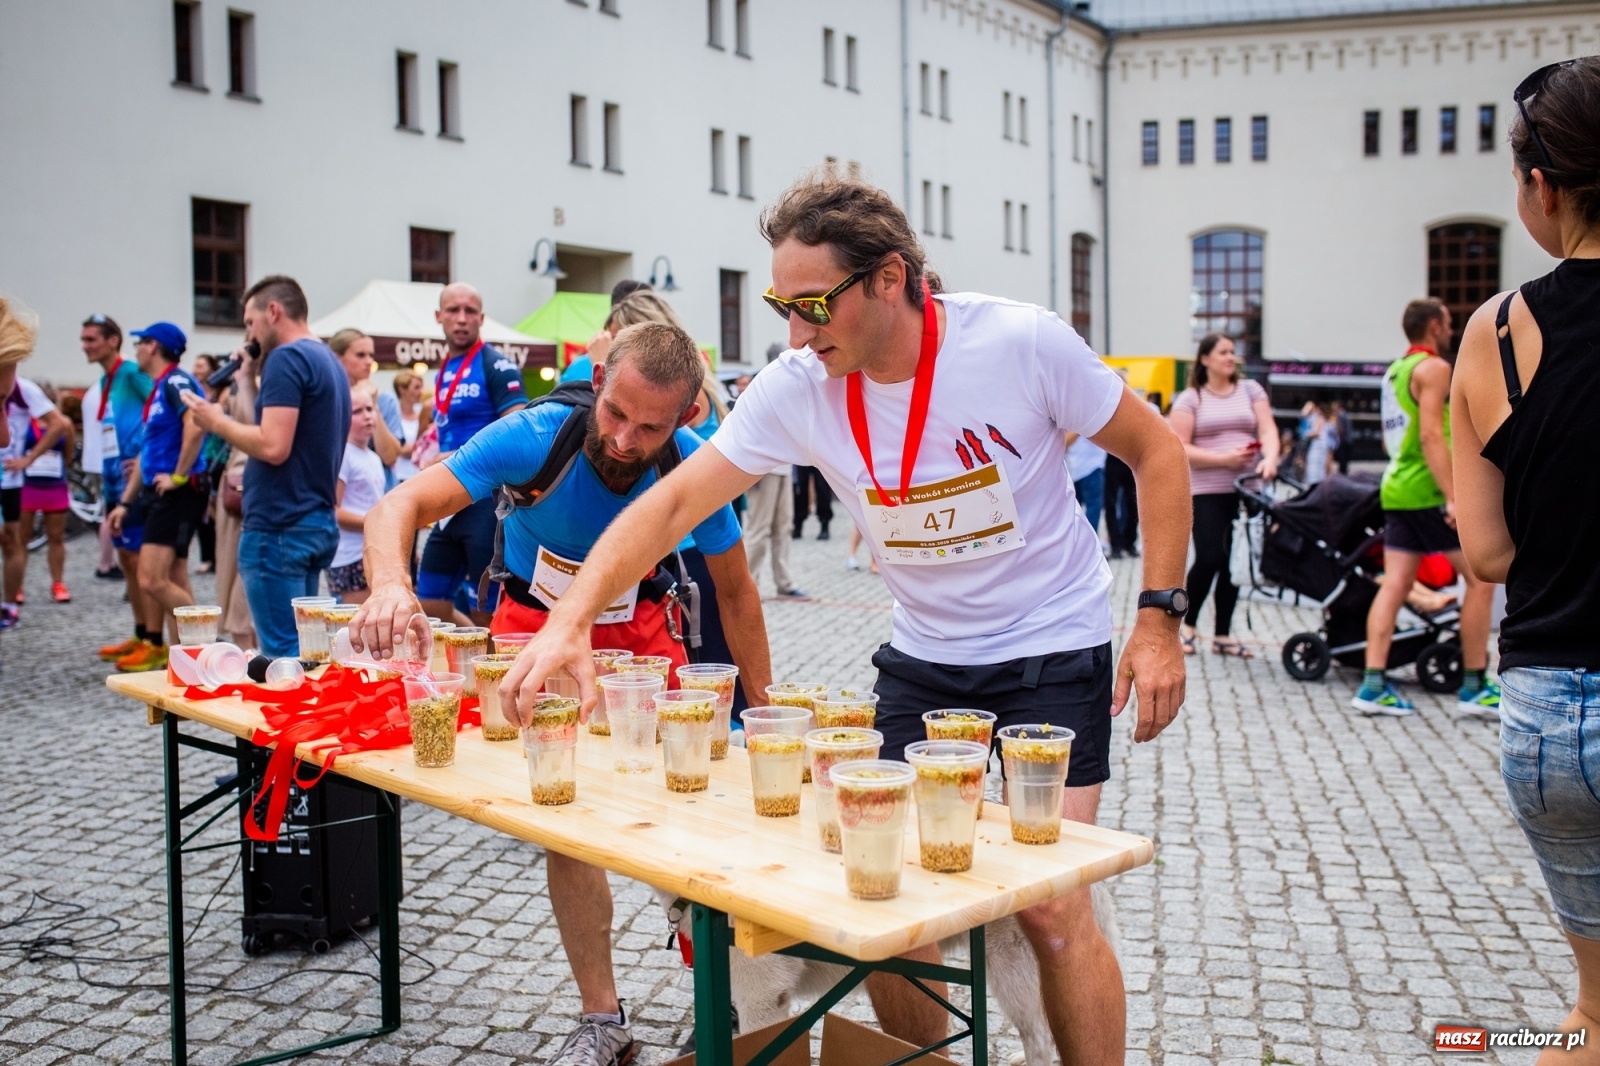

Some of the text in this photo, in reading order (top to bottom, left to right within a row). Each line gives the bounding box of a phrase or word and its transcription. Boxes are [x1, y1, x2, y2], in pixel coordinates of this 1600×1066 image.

[912, 491, 941, 500] Wokół
[944, 480, 982, 493] Komina
[923, 508, 955, 531] 47
